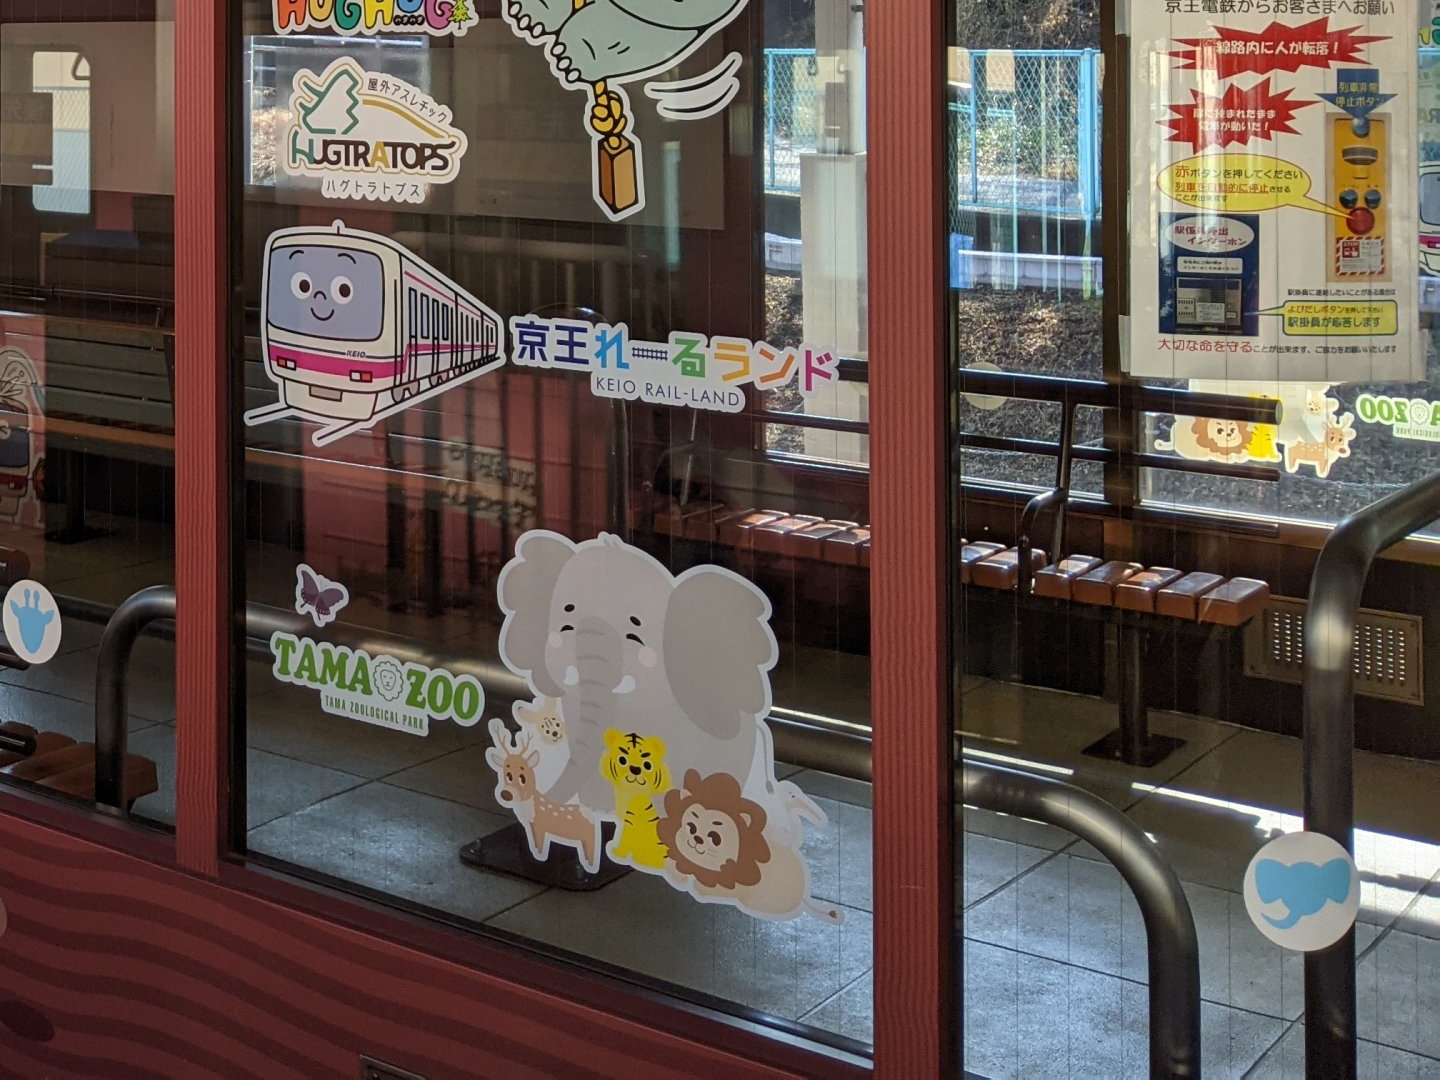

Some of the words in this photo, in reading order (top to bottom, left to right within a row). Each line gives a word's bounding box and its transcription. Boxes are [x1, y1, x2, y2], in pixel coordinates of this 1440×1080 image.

[368, 77, 447, 123] 屋外アスレチック
[291, 130, 457, 172] HUGTRATOPS
[1174, 164, 1304, 181] 赤ボタンを押してください
[596, 376, 636, 395] KEIO
[645, 382, 740, 407] RAIL-LAND
[274, 637, 374, 697] TAMA
[406, 668, 480, 721] ZOO
[324, 694, 347, 710] TAMA
[349, 699, 400, 726] ZOOLOGICAL
[402, 713, 425, 731] PARK
